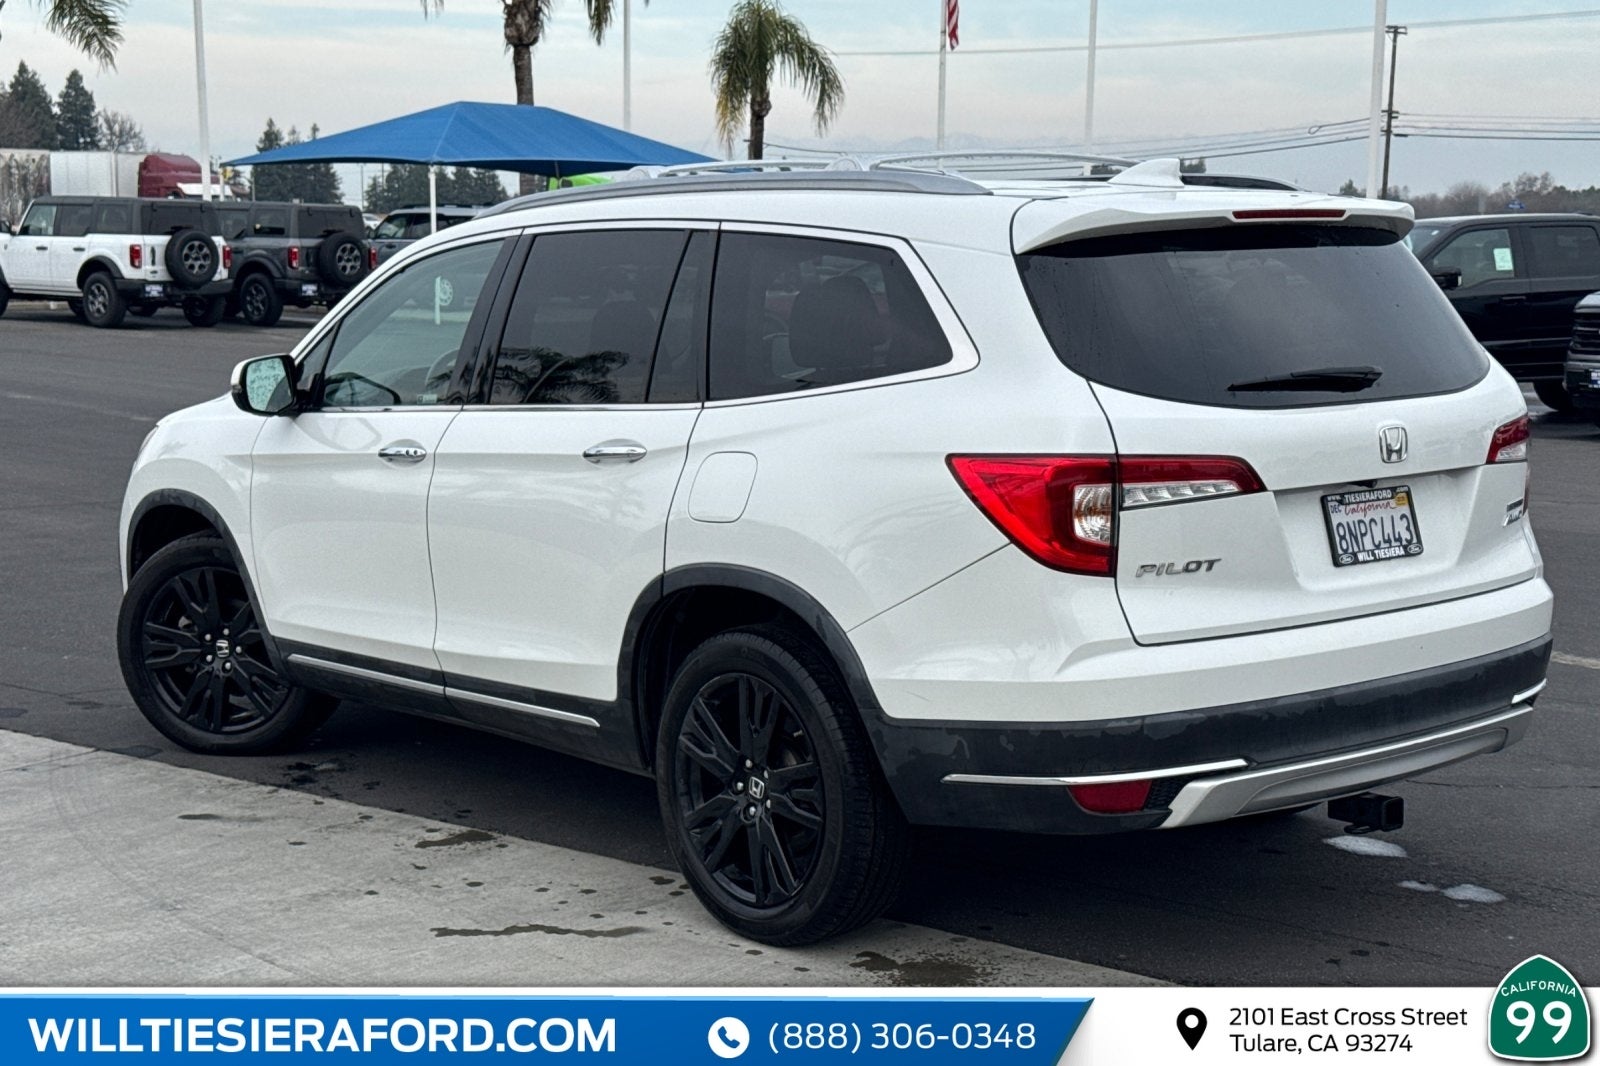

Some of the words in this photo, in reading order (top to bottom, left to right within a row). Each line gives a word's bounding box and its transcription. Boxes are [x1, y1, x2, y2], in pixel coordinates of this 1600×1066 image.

[1344, 490, 1392, 503] TIESIERAFORD
[1330, 504, 1342, 513] DEC
[1344, 501, 1397, 517] California
[1336, 514, 1413, 553] 8NPC443
[1357, 550, 1374, 562] WILL
[1374, 547, 1405, 559] TIESIERA
[1136, 558, 1222, 577] PILOT
